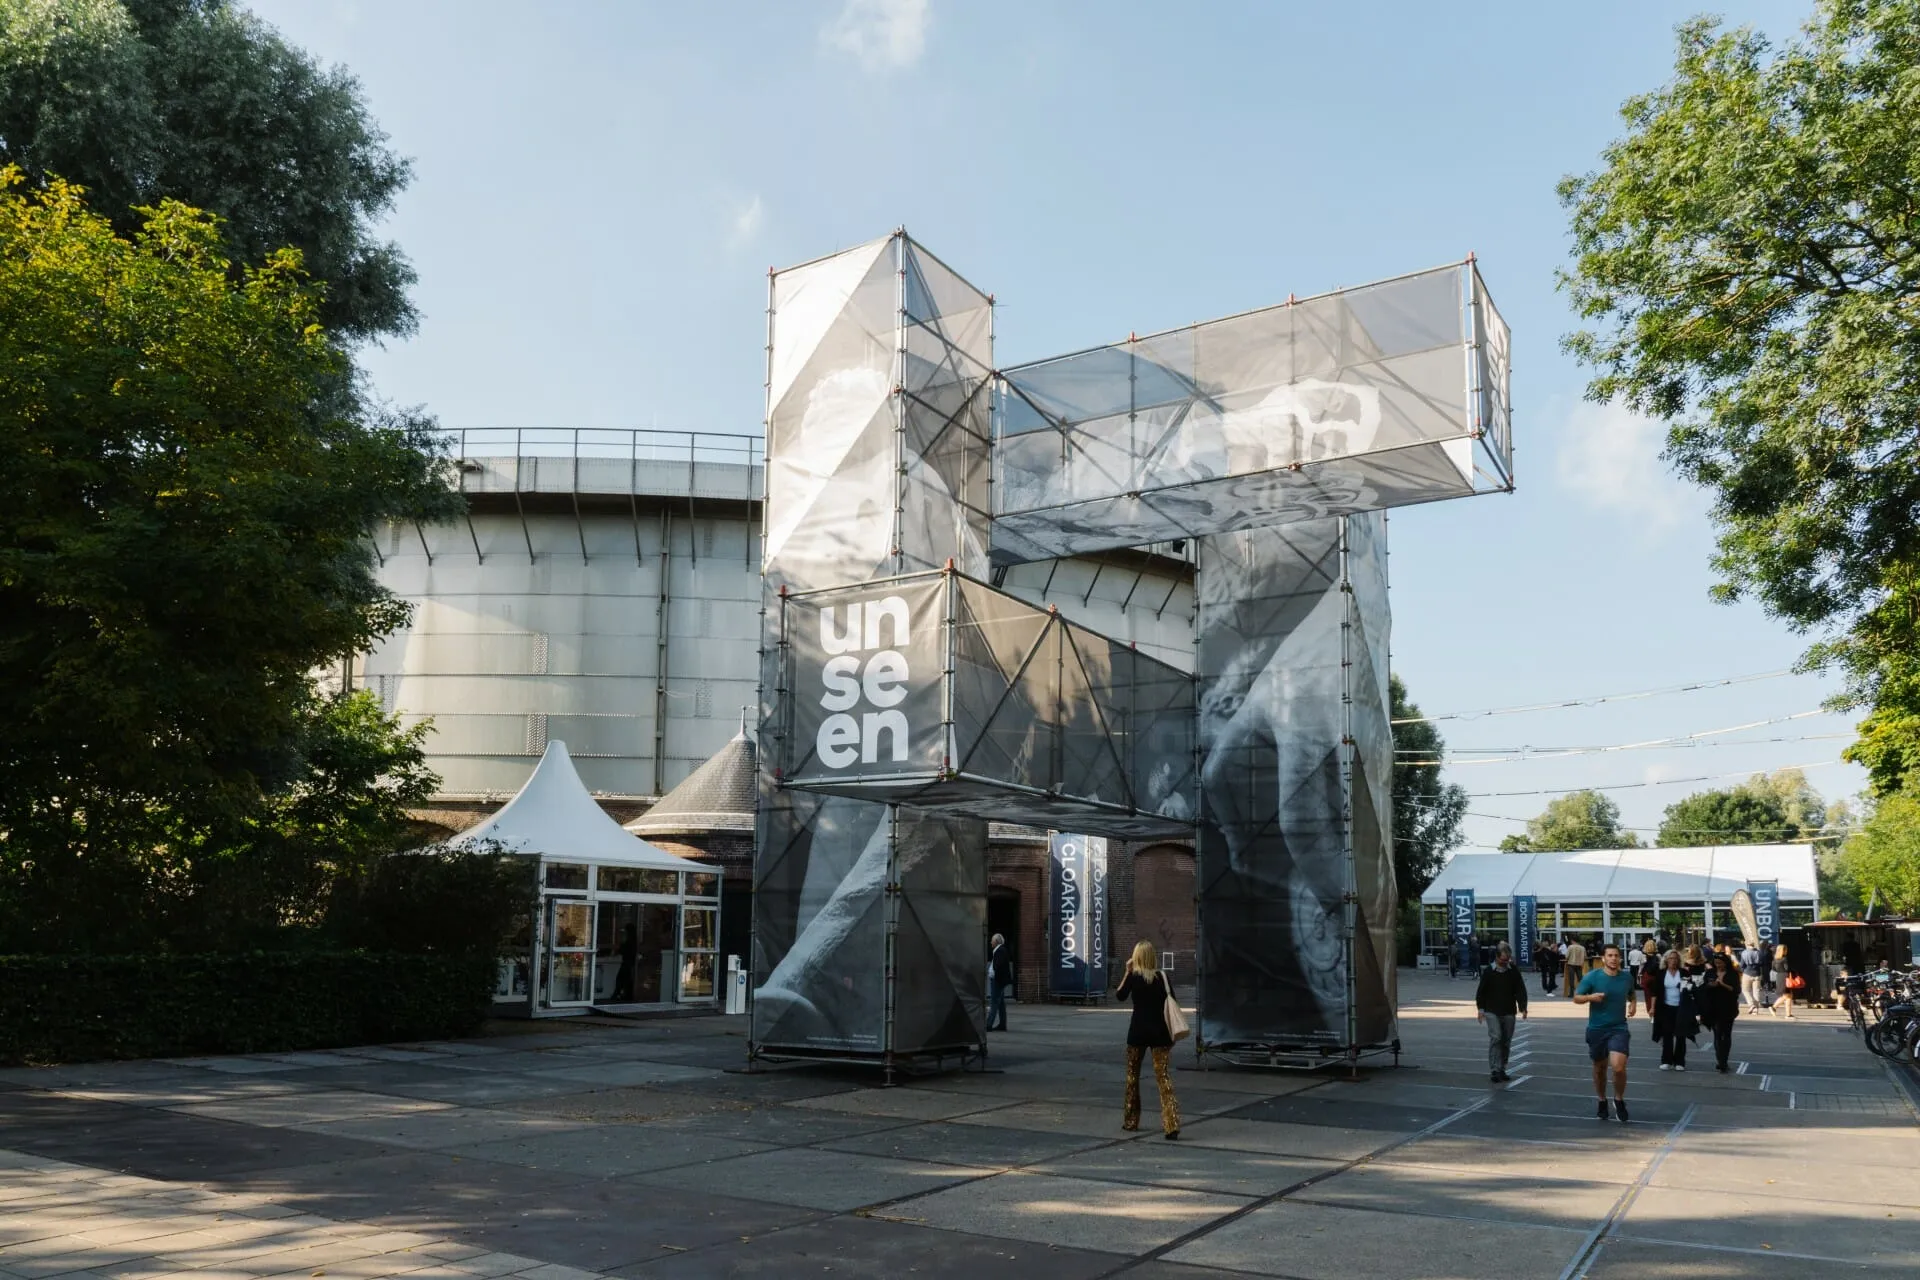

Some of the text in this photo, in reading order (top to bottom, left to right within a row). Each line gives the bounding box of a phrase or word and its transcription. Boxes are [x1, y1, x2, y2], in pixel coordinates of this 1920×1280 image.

[820, 595, 910, 655] un
[819, 649, 909, 712] se
[817, 709, 909, 769] en
[1061, 843, 1075, 969] CLOAKROOM
[1093, 844, 1102, 969] CLOAKROOM
[1455, 895, 1471, 936] FAIR
[1519, 901, 1529, 964] BOOK MARKET
[1755, 889, 1773, 943] UNBO
